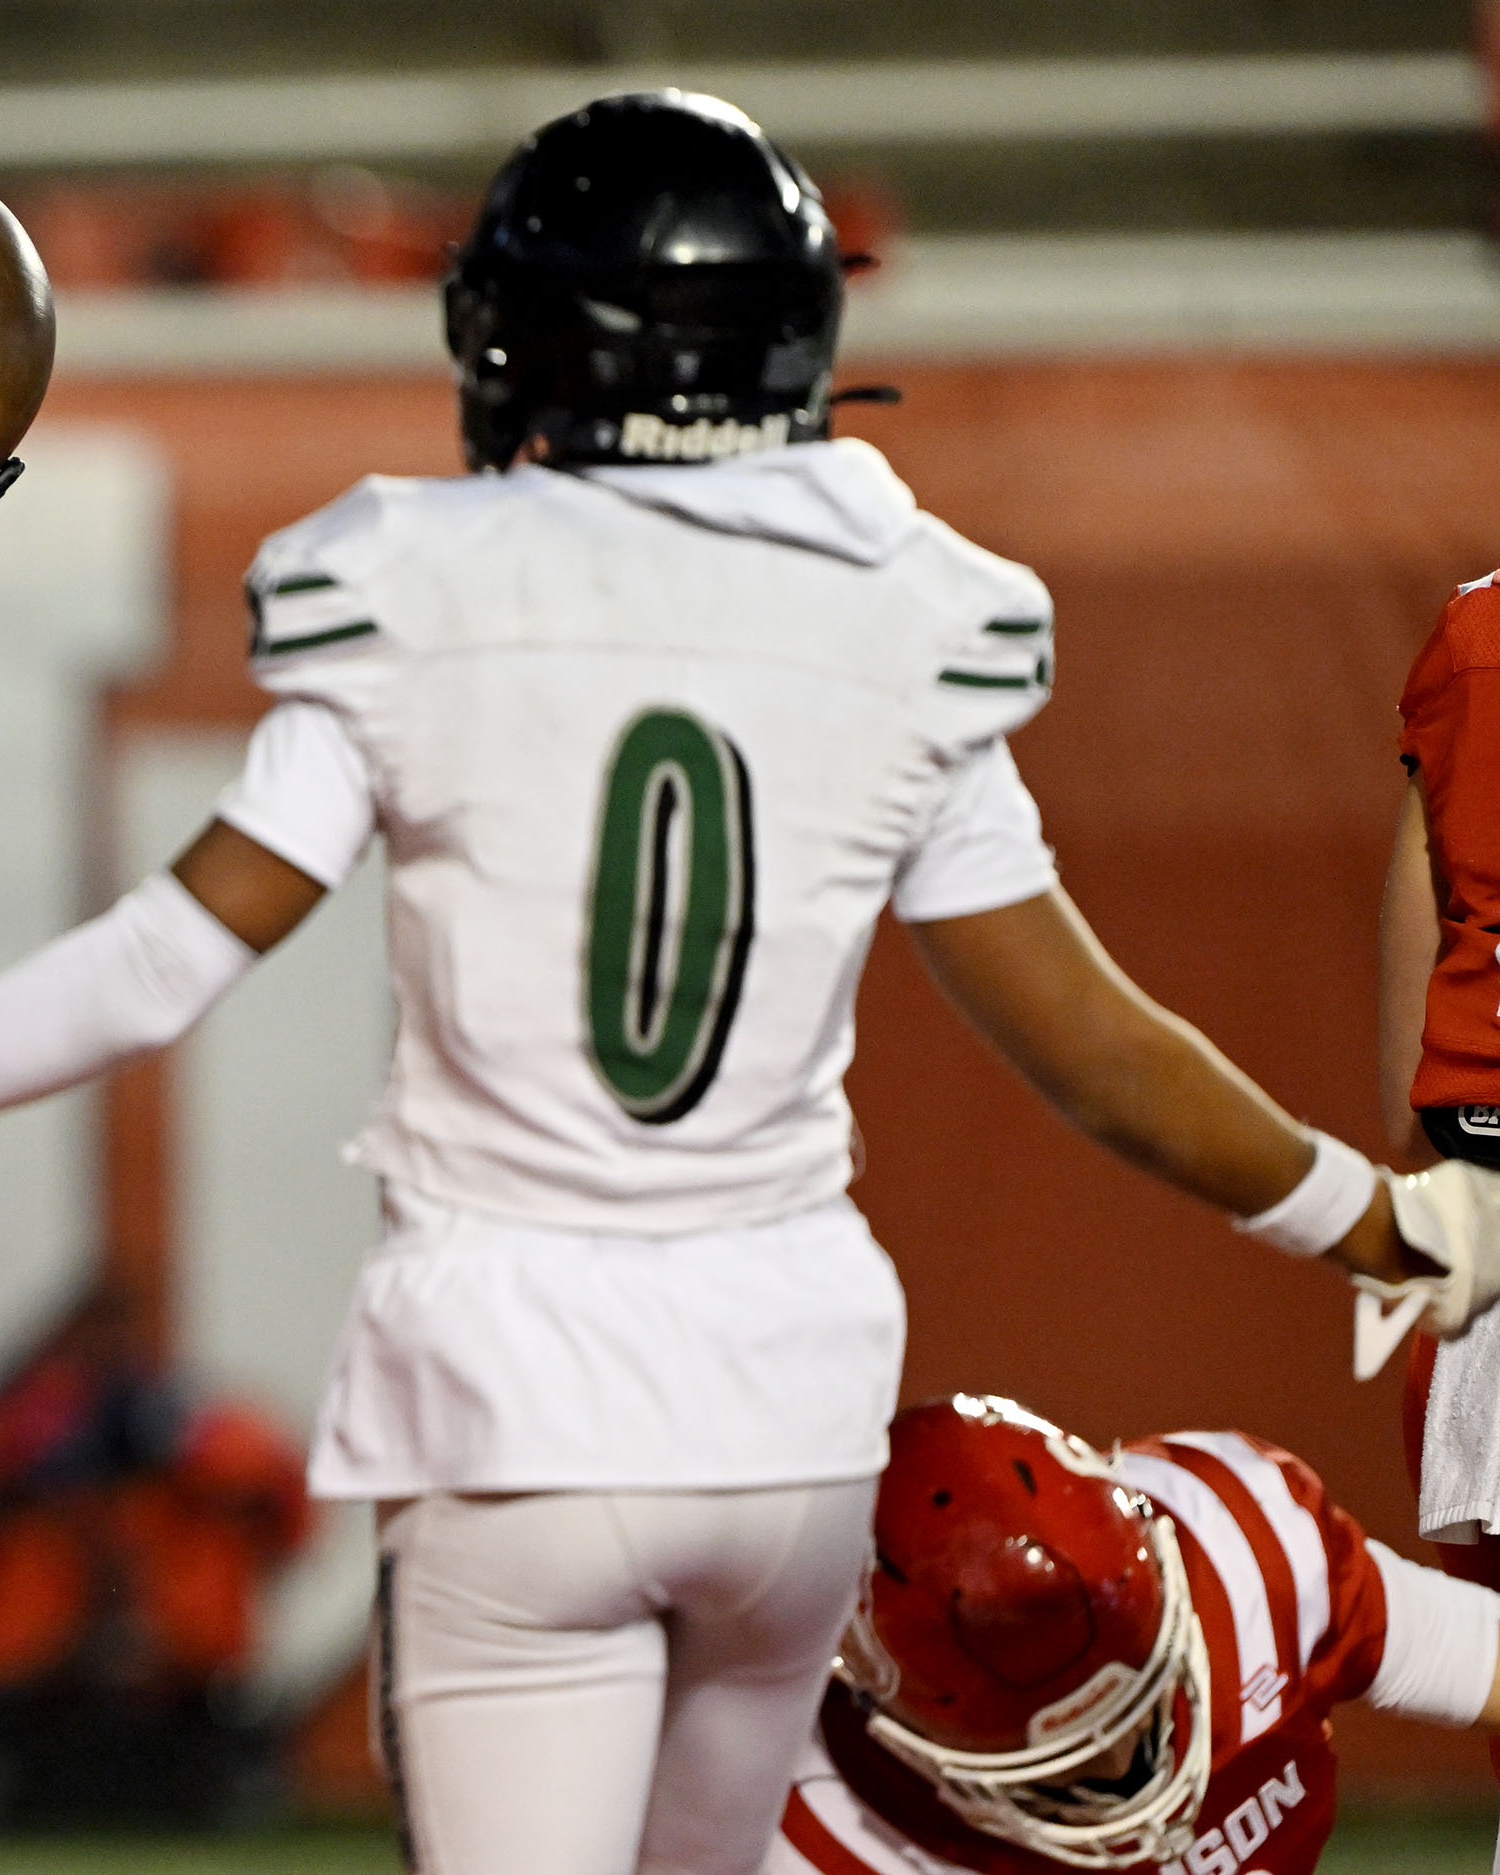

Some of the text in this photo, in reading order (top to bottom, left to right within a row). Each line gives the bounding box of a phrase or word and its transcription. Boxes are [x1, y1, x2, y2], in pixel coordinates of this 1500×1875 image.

[619, 412, 791, 461] Riddell
[580, 702, 756, 1125] 0
[1158, 1758, 1307, 1875] SON
